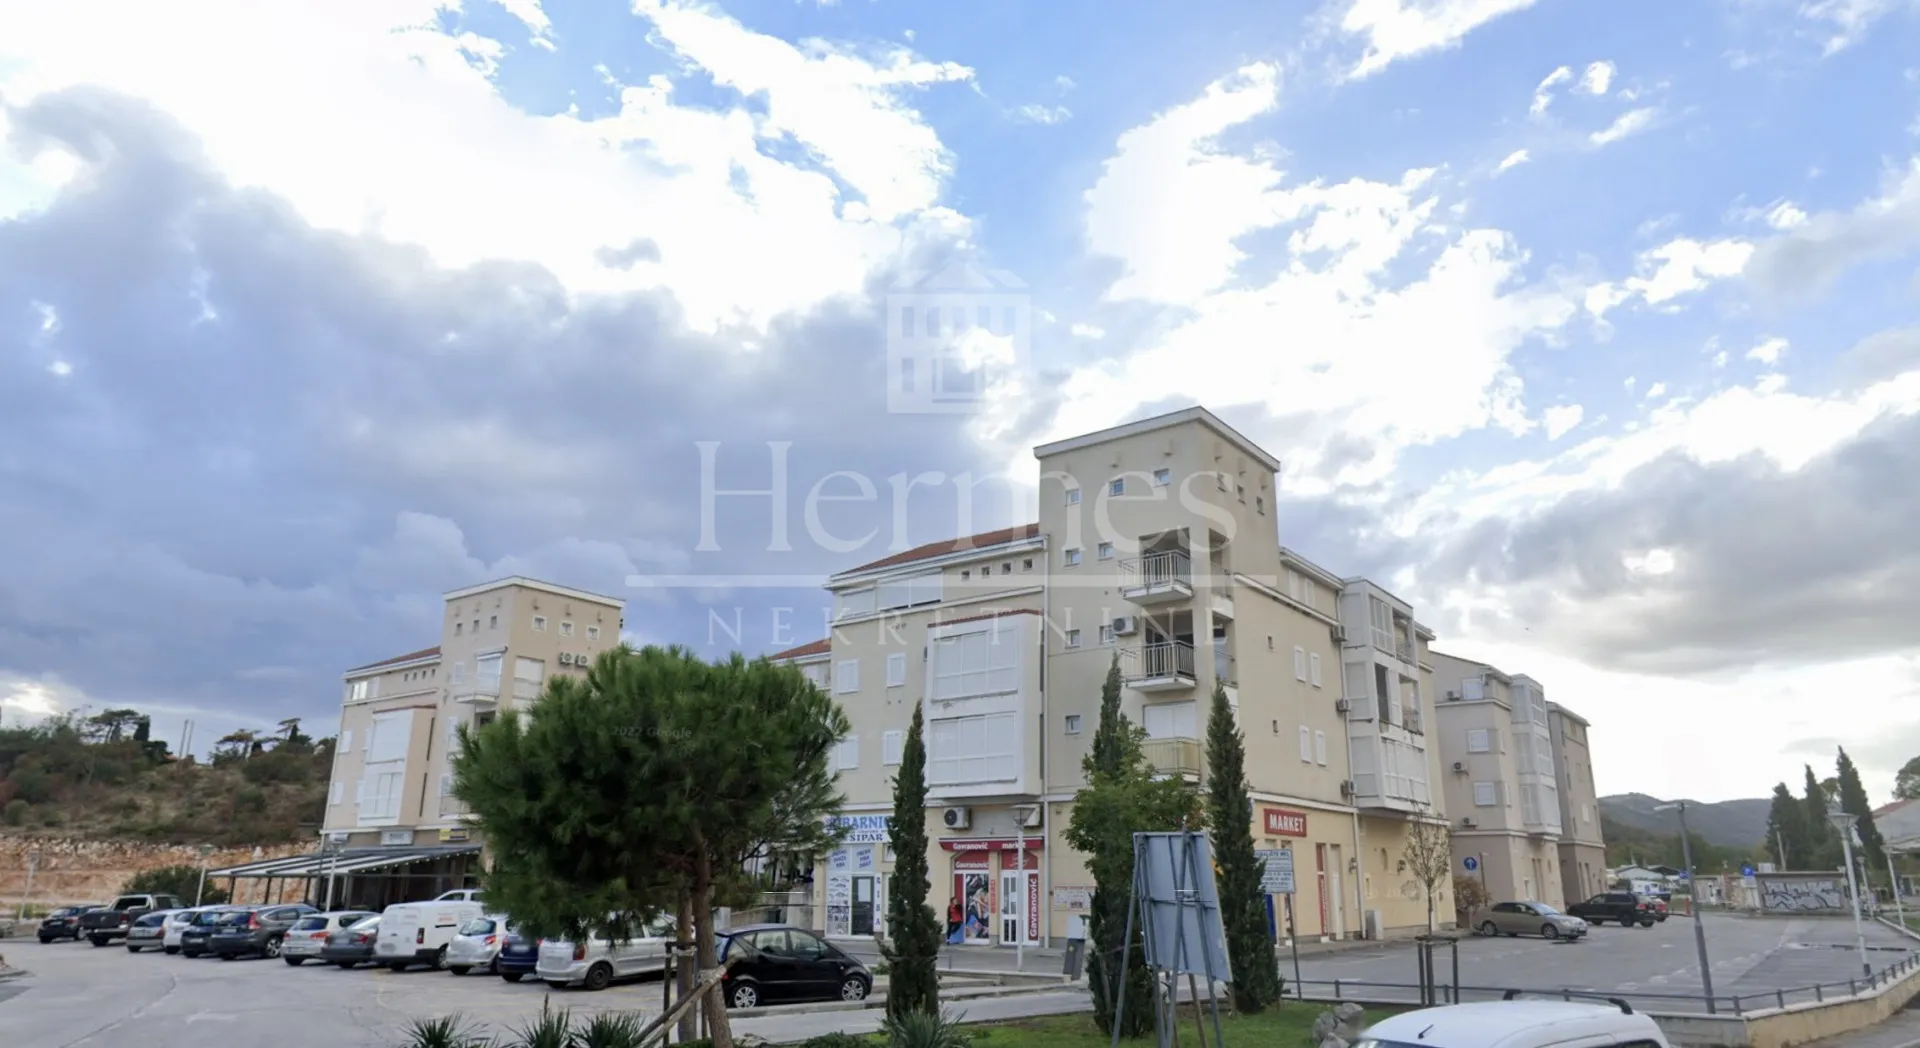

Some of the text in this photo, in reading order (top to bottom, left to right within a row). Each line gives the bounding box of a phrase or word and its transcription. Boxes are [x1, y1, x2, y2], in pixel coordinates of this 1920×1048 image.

[1269, 813, 1304, 833] MARKET
[850, 834, 883, 842] SIPAR
[953, 842, 988, 850] Gavranović
[1029, 877, 1038, 938] Gavranović
